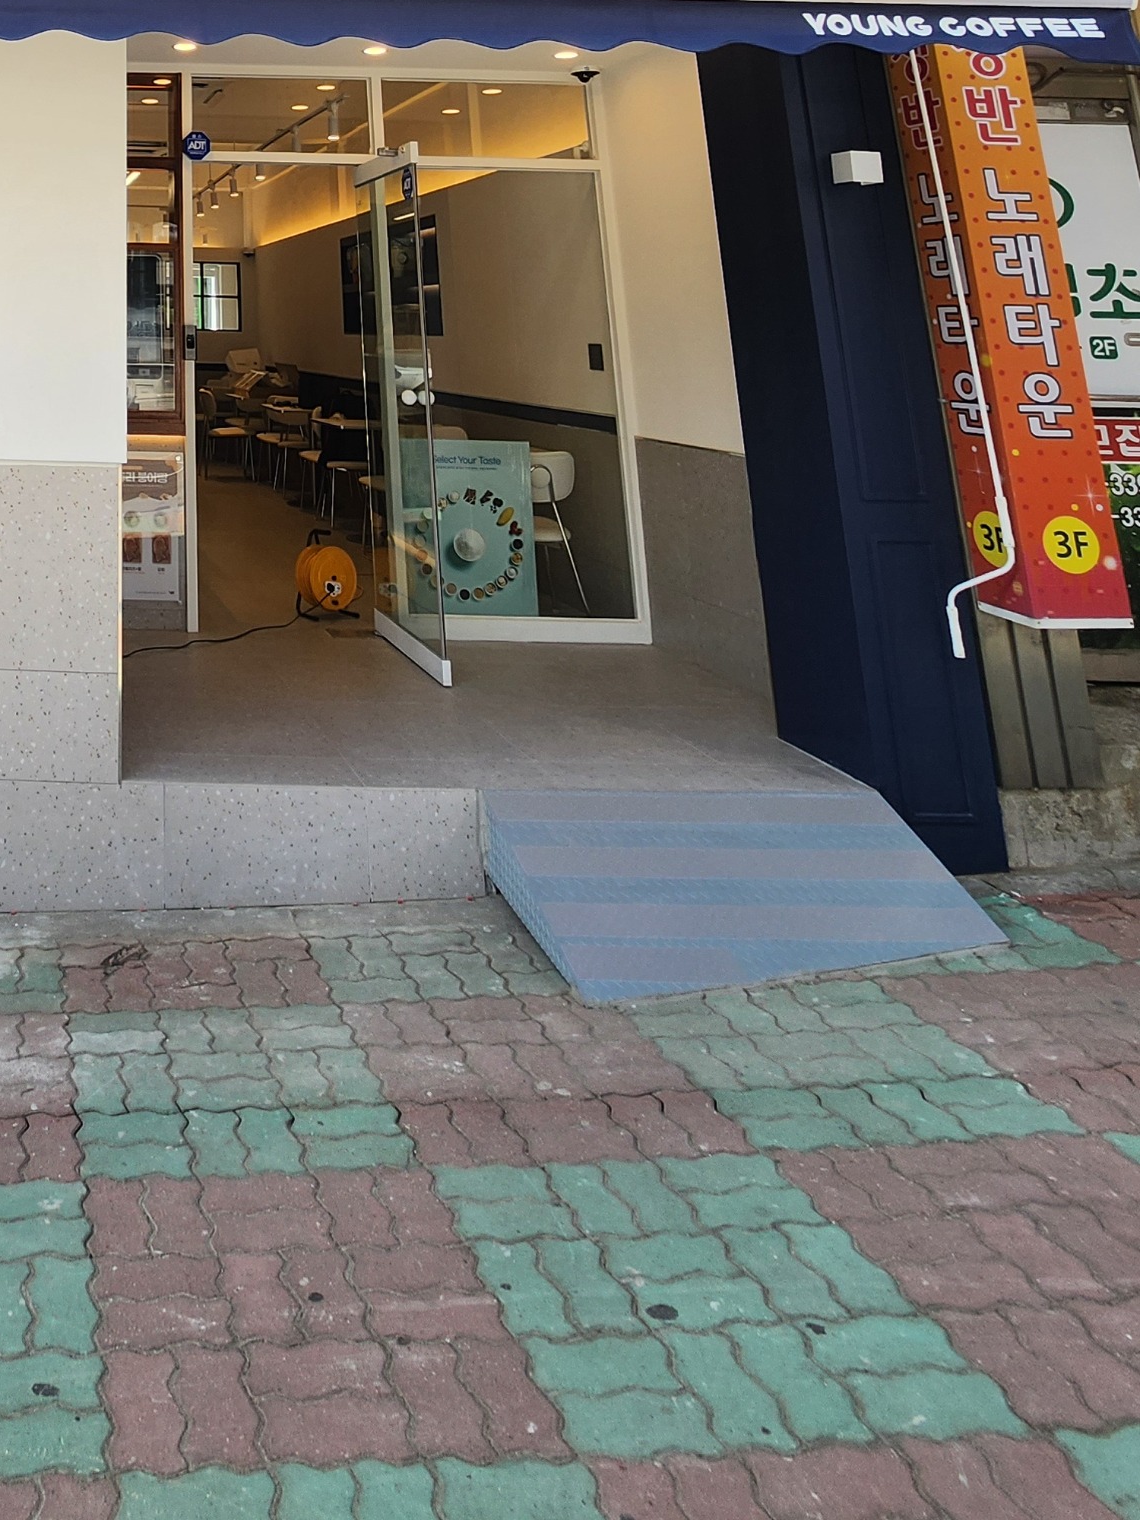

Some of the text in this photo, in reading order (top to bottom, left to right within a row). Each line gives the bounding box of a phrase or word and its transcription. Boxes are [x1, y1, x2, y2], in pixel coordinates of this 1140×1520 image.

[802, 13, 1106, 39] YOUNG COFFEE
[188, 140, 206, 150] ADT
[982, 167, 1075, 439] 노래타운
[1092, 339, 1116, 356] 2F
[458, 455, 477, 465] Your
[478, 455, 502, 466] Taste
[1104, 473, 1140, 496] -33
[979, 524, 1004, 554] 3F
[1053, 530, 1089, 559] 3F
